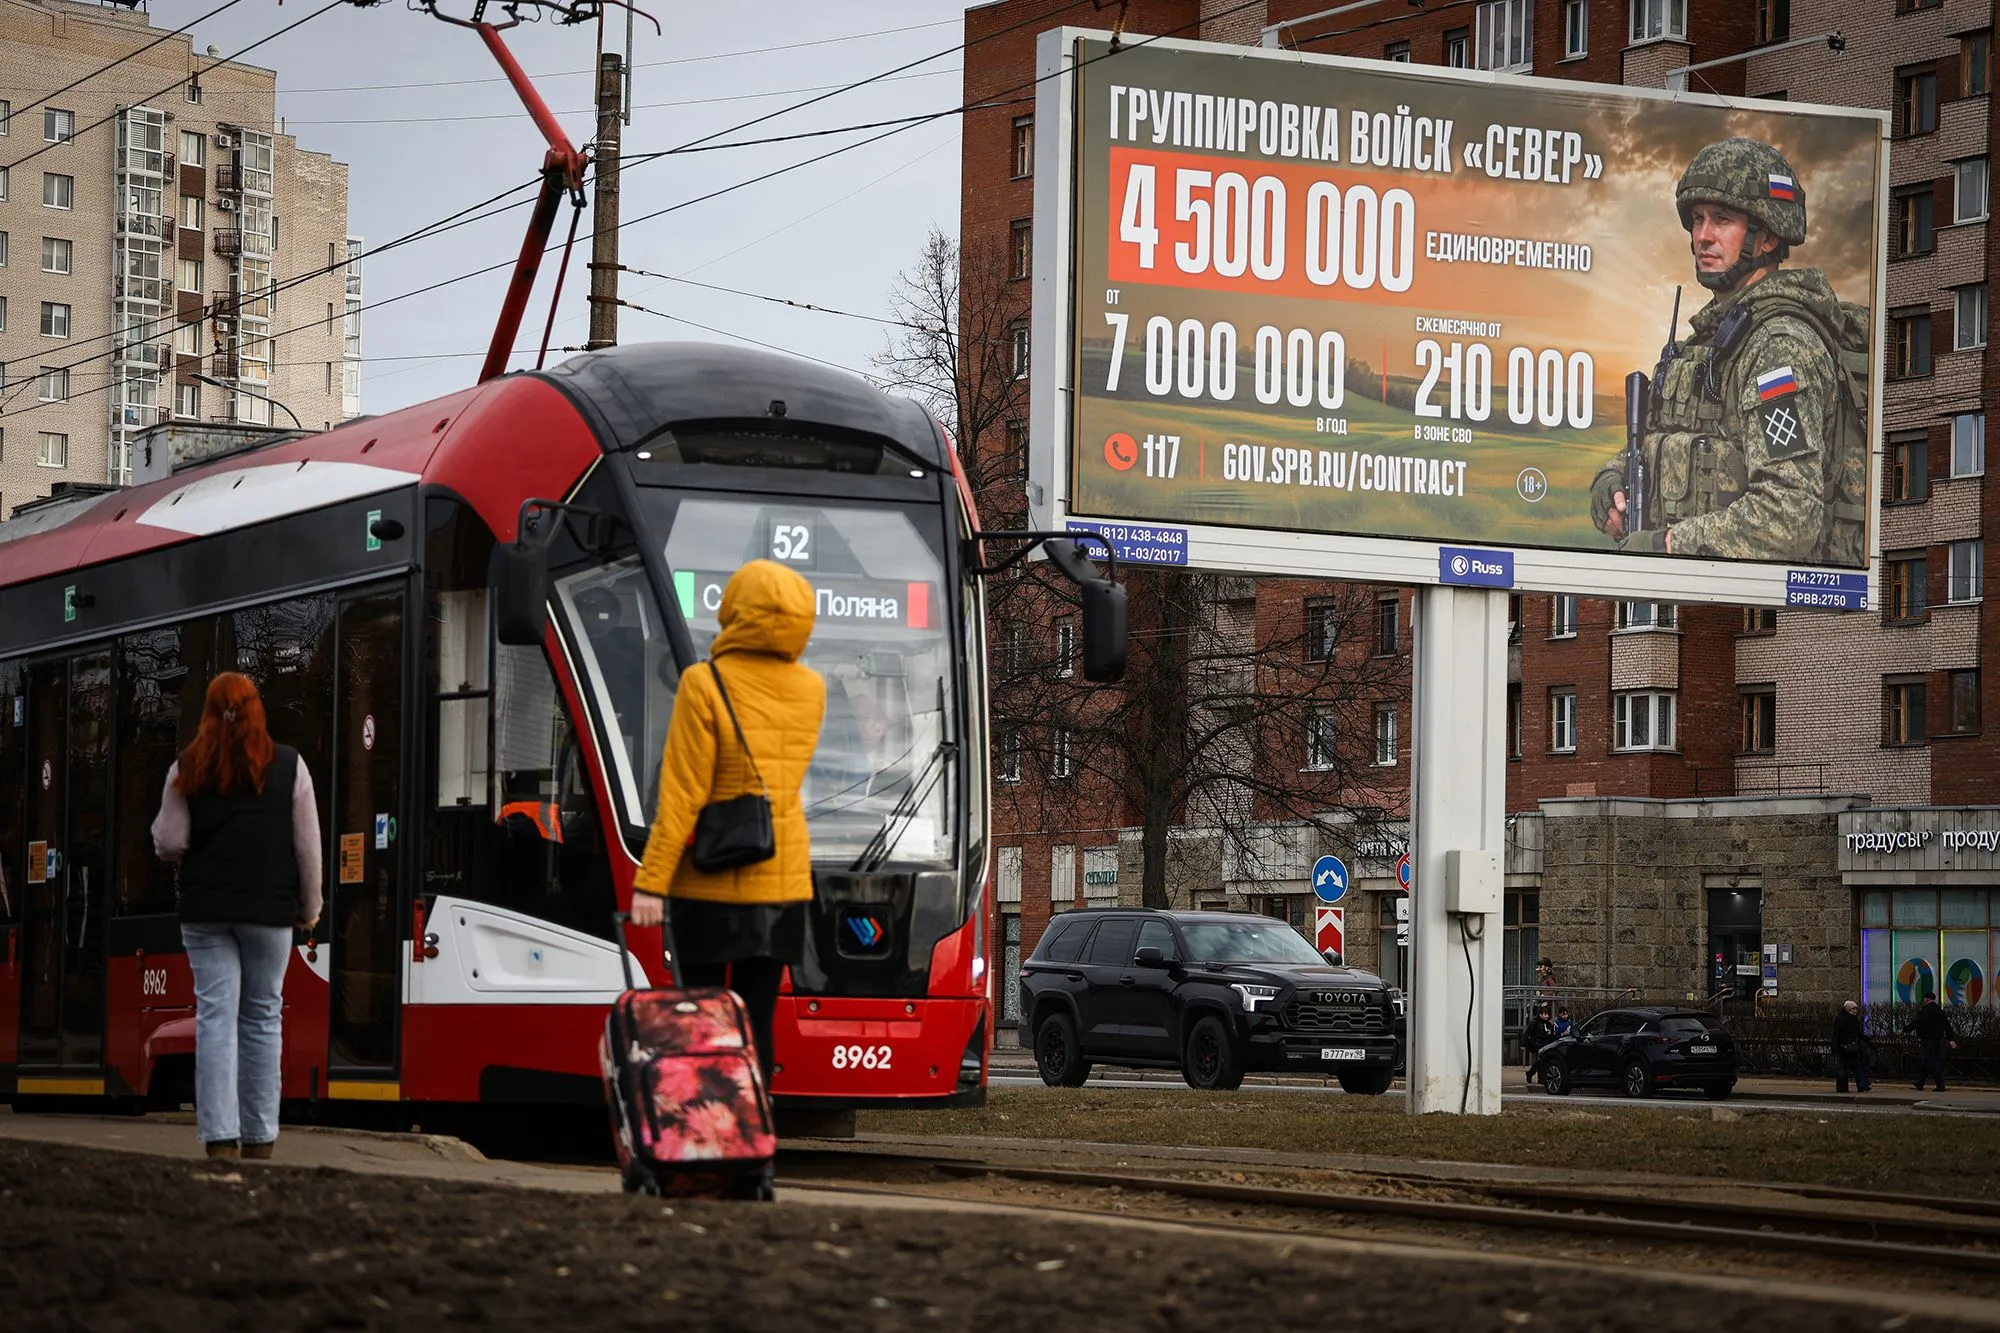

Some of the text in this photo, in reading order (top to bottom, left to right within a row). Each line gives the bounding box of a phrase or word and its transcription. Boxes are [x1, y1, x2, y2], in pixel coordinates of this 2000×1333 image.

[1109, 85, 1604, 184] ГРУППИРОВКА ВОЙСК «СЕВЕР»
[1119, 163, 1416, 293] 4 500 000
[1425, 232, 1592, 272] ЕДИНОВРЕМЕННО
[1106, 289, 1120, 305] ОТ
[1416, 317, 1502, 338] ЕЖЕМЕСЯЧНО ОТ
[1104, 312, 1345, 410] 7 000 000
[1414, 339, 1594, 429] 210 000
[1316, 417, 1348, 435] В ГОД
[1414, 425, 1472, 444] В ЗОНЕ СВО
[1143, 434, 1180, 479] 117
[1223, 443, 1467, 497] GOV.SPB.RU/CONTRACT
[1523, 475, 1542, 493] 18+
[773, 525, 809, 560] 52
[1099, 525, 1128, 541] (812)
[1130, 529, 1183, 544] 438-4848
[1123, 546, 1181, 562] Т-03/2017
[1471, 560, 1503, 575] Russ
[1790, 572, 1840, 586] PM:27721
[815, 589, 898, 619] Поляна
[1790, 592, 1867, 608] SPBB:2750 Б
[143, 969, 167, 995] 8962
[1316, 992, 1367, 1003] TOYOTA
[831, 1044, 892, 1070] 8962
